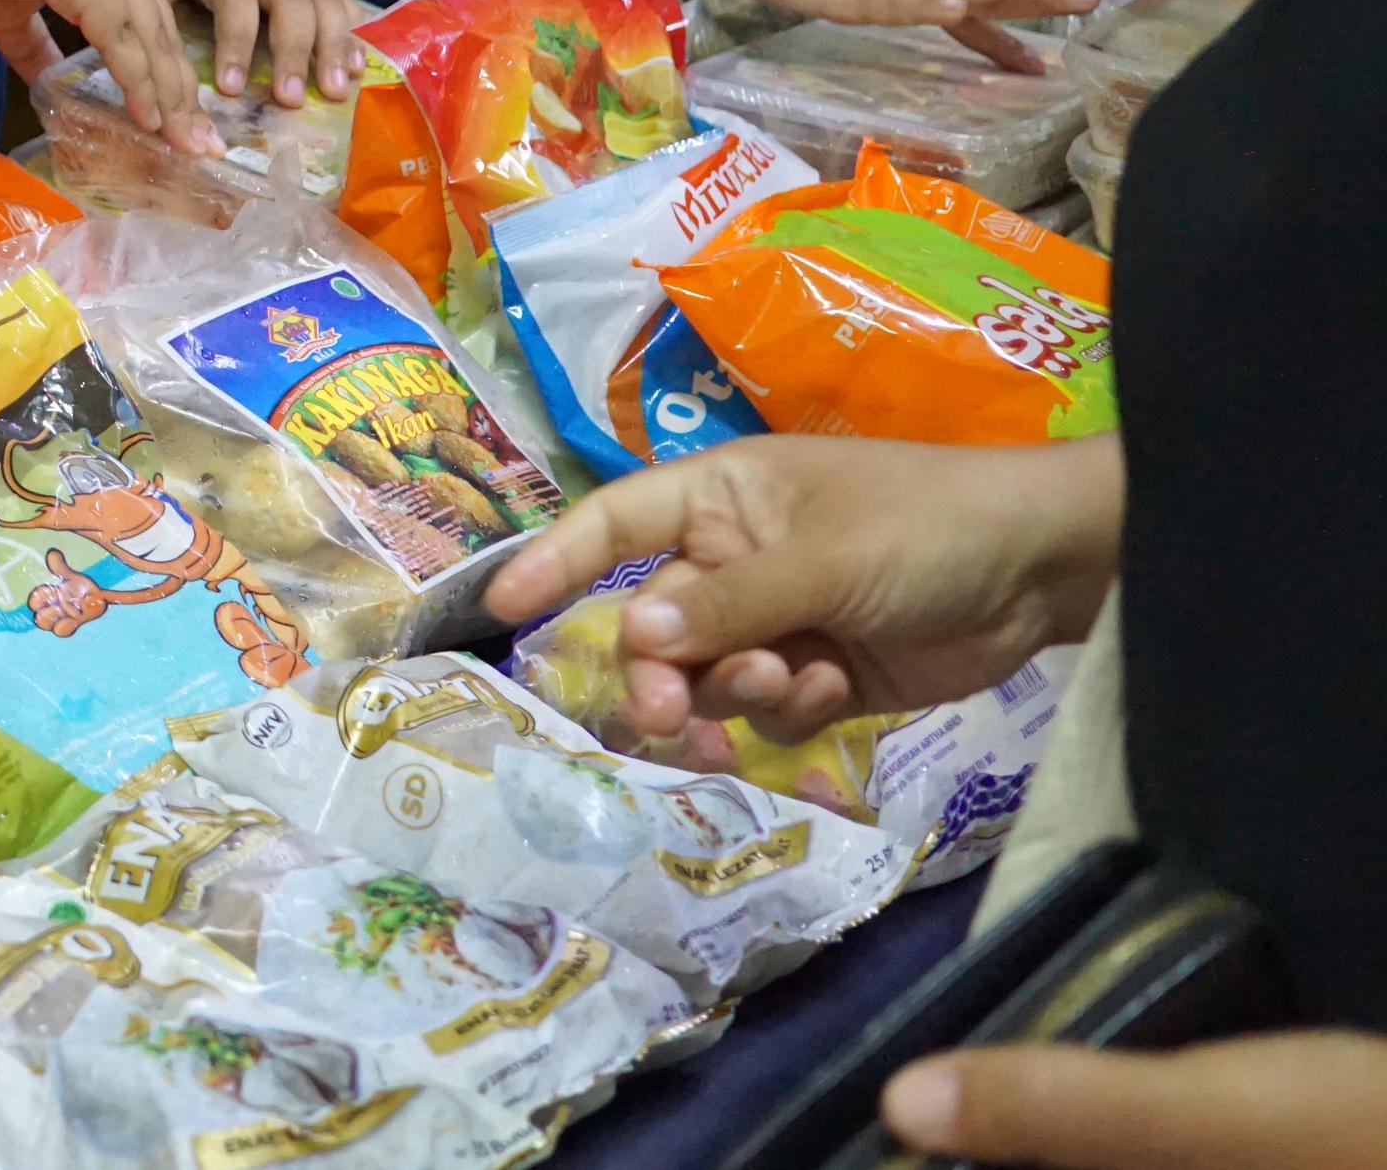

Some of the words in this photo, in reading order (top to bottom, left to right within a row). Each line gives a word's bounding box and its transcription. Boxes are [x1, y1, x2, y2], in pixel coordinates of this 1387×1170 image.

[670, 139, 776, 243] MINAKU
[833, 291, 887, 351] PBS
[285, 373, 377, 457] KAKI
[350, 356, 472, 401] NAGA
[370, 407, 437, 449] Ikan
[253, 709, 284, 747] NKV
[400, 772, 428, 820] SD
[864, 852, 886, 874] 25
